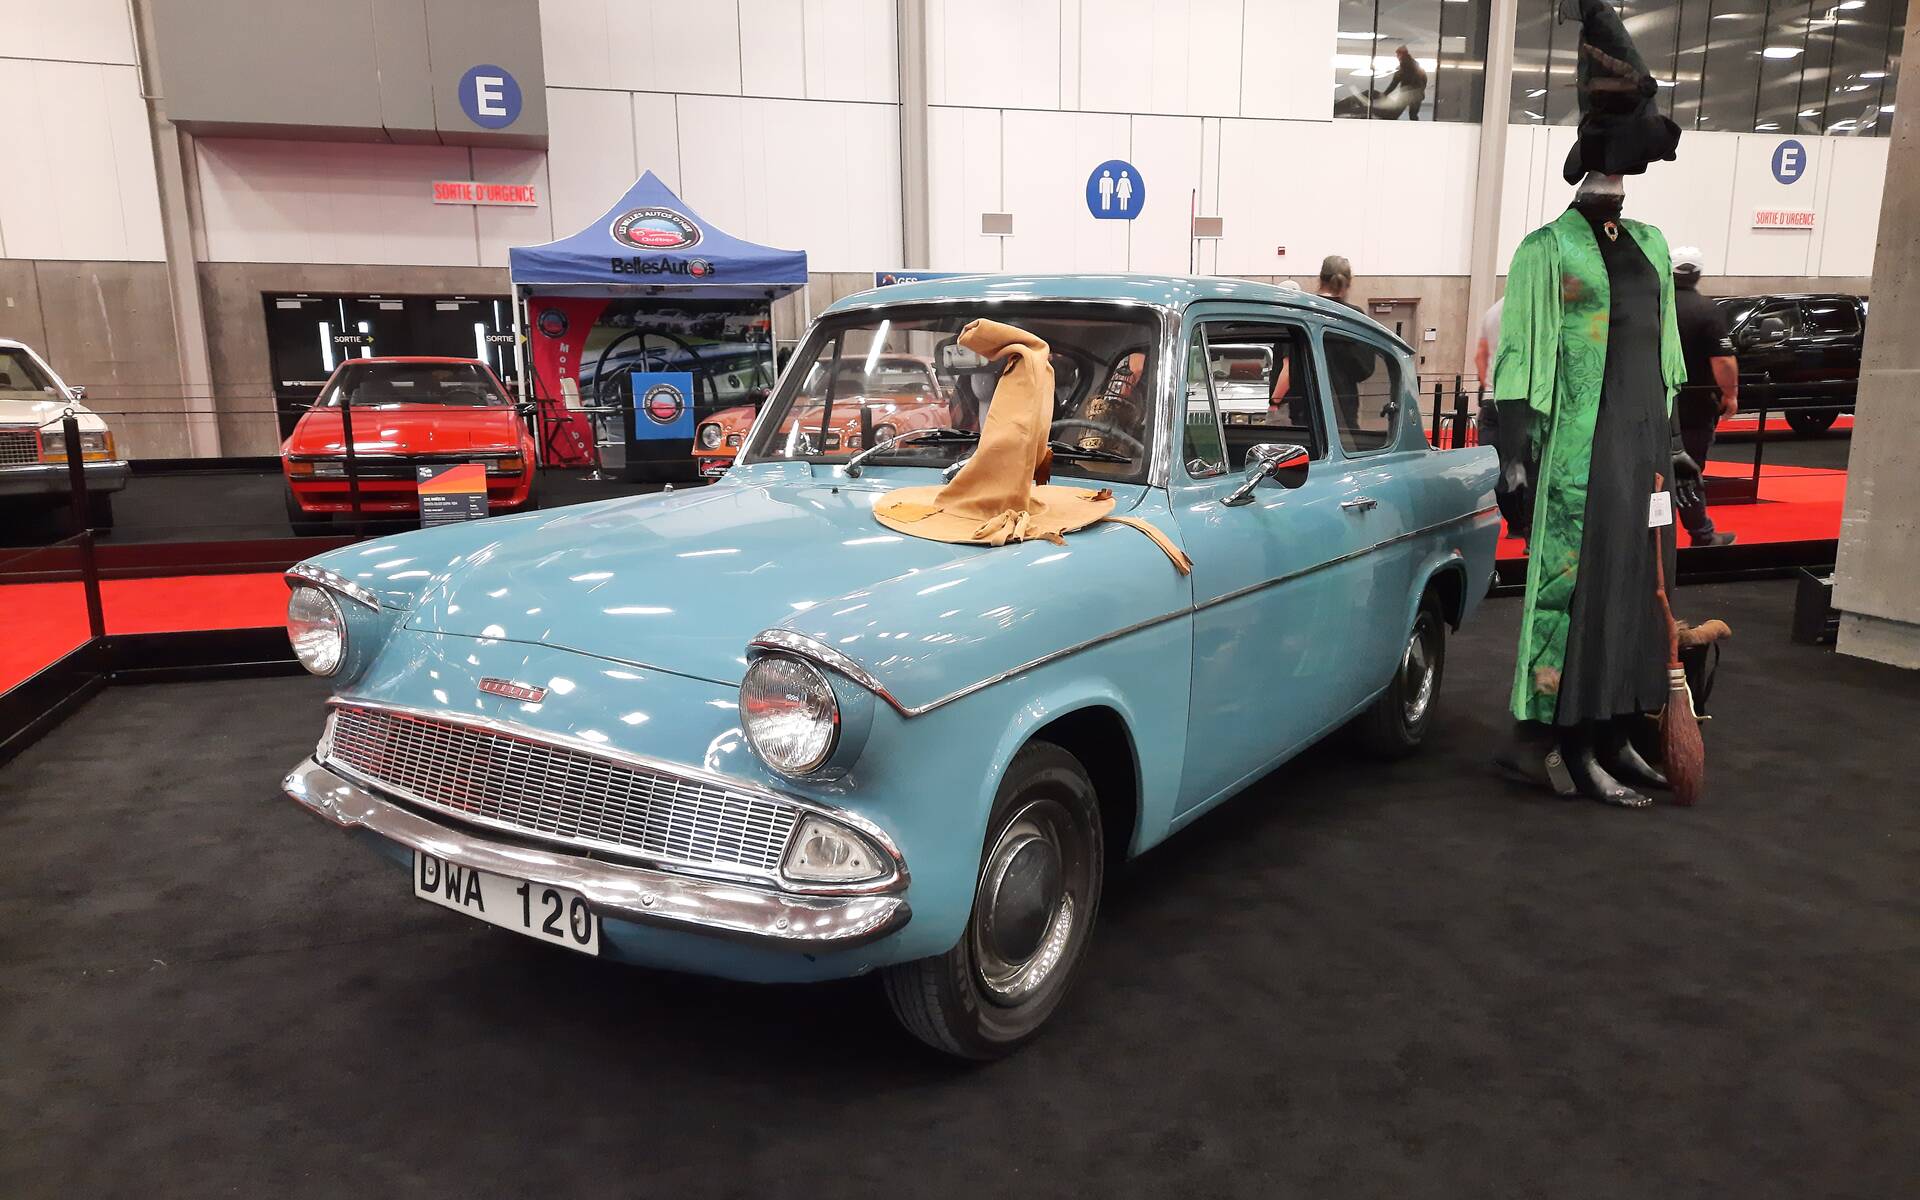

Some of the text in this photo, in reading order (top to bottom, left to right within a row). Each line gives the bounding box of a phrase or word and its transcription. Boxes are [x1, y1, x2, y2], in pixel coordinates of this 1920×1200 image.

[475, 76, 507, 116] E
[1780, 148, 1799, 176] E
[434, 183, 535, 202] SORTIE D'URGENCE
[1756, 211, 1815, 226] SORTIE D'URGENCE
[334, 335, 362, 343] SORTIE
[486, 335, 514, 343] SORTIE
[420, 852, 592, 945] DWA 120
